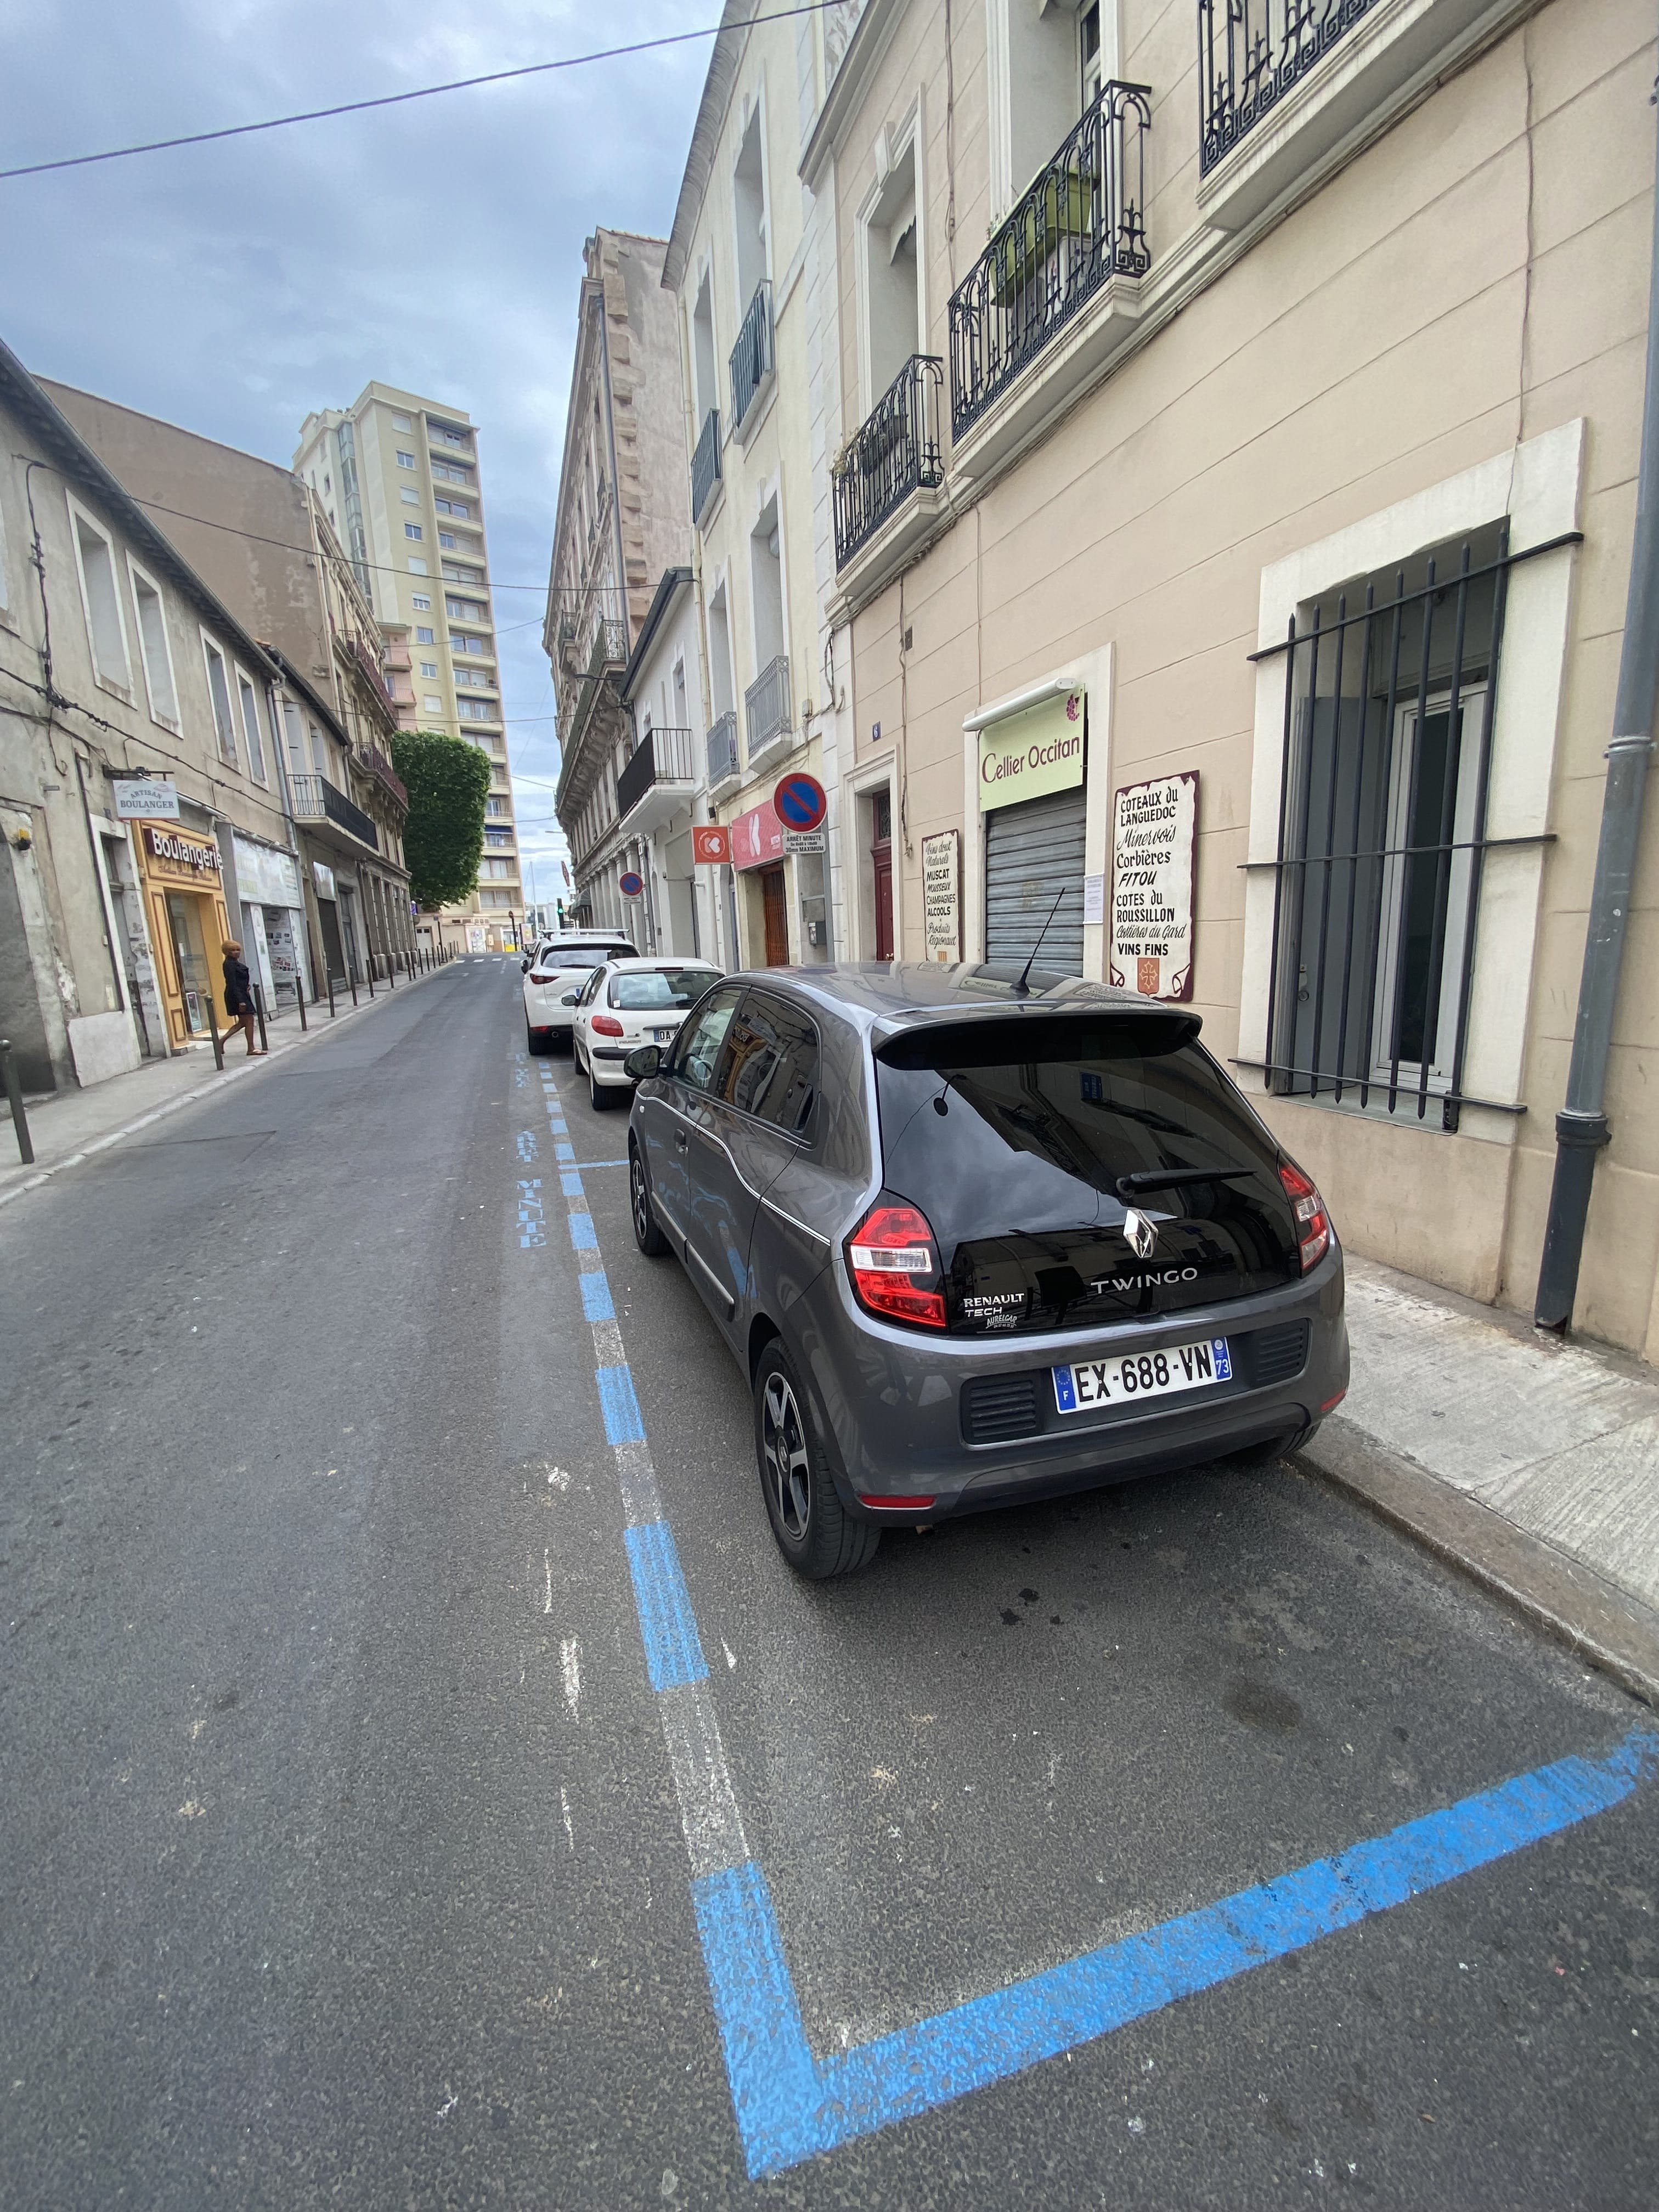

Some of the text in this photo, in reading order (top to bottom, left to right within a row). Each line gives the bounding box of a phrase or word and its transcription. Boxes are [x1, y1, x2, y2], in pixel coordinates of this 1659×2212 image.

[874, 725, 878, 738] 6
[982, 737, 1080, 783] Cellier Occitan
[131, 790, 162, 799] ARTISAN
[1121, 786, 1178, 813] COTEAUX du
[120, 800, 174, 809] BOULANGER
[1121, 805, 1176, 827] LANGUEDOC
[1116, 824, 1176, 850] Minervois
[151, 828, 224, 870] Boulangerie
[926, 840, 952, 855] Vins doux
[926, 853, 949, 867] Naturels
[1117, 849, 1171, 868] Corbières
[927, 868, 950, 882] MUSCAT
[1118, 871, 1157, 888] FITOU
[927, 882, 951, 893] MOUSSEUX
[927, 894, 956, 905] CHAMPAGNES
[1116, 893, 1144, 907] COTES
[1150, 889, 1163, 905] du
[927, 906, 951, 917] ALCOOLS
[1117, 907, 1175, 923] ROUSSILLON
[927, 922, 950, 934] Produits
[1116, 923, 1187, 940] Costières du Gard
[928, 934, 956, 950] Régionaux
[1118, 943, 1169, 956] VINS FINS
[1090, 1267, 1198, 1294] TWINGO
[963, 1293, 1024, 1307] RENAULT
[965, 1306, 1002, 1317] TECH
[987, 1314, 1017, 1326] AURELCAR
[1063, 1391, 1069, 1401] F
[1075, 1345, 1212, 1403] EX-688-VN
[1216, 1358, 1229, 1375] 73
